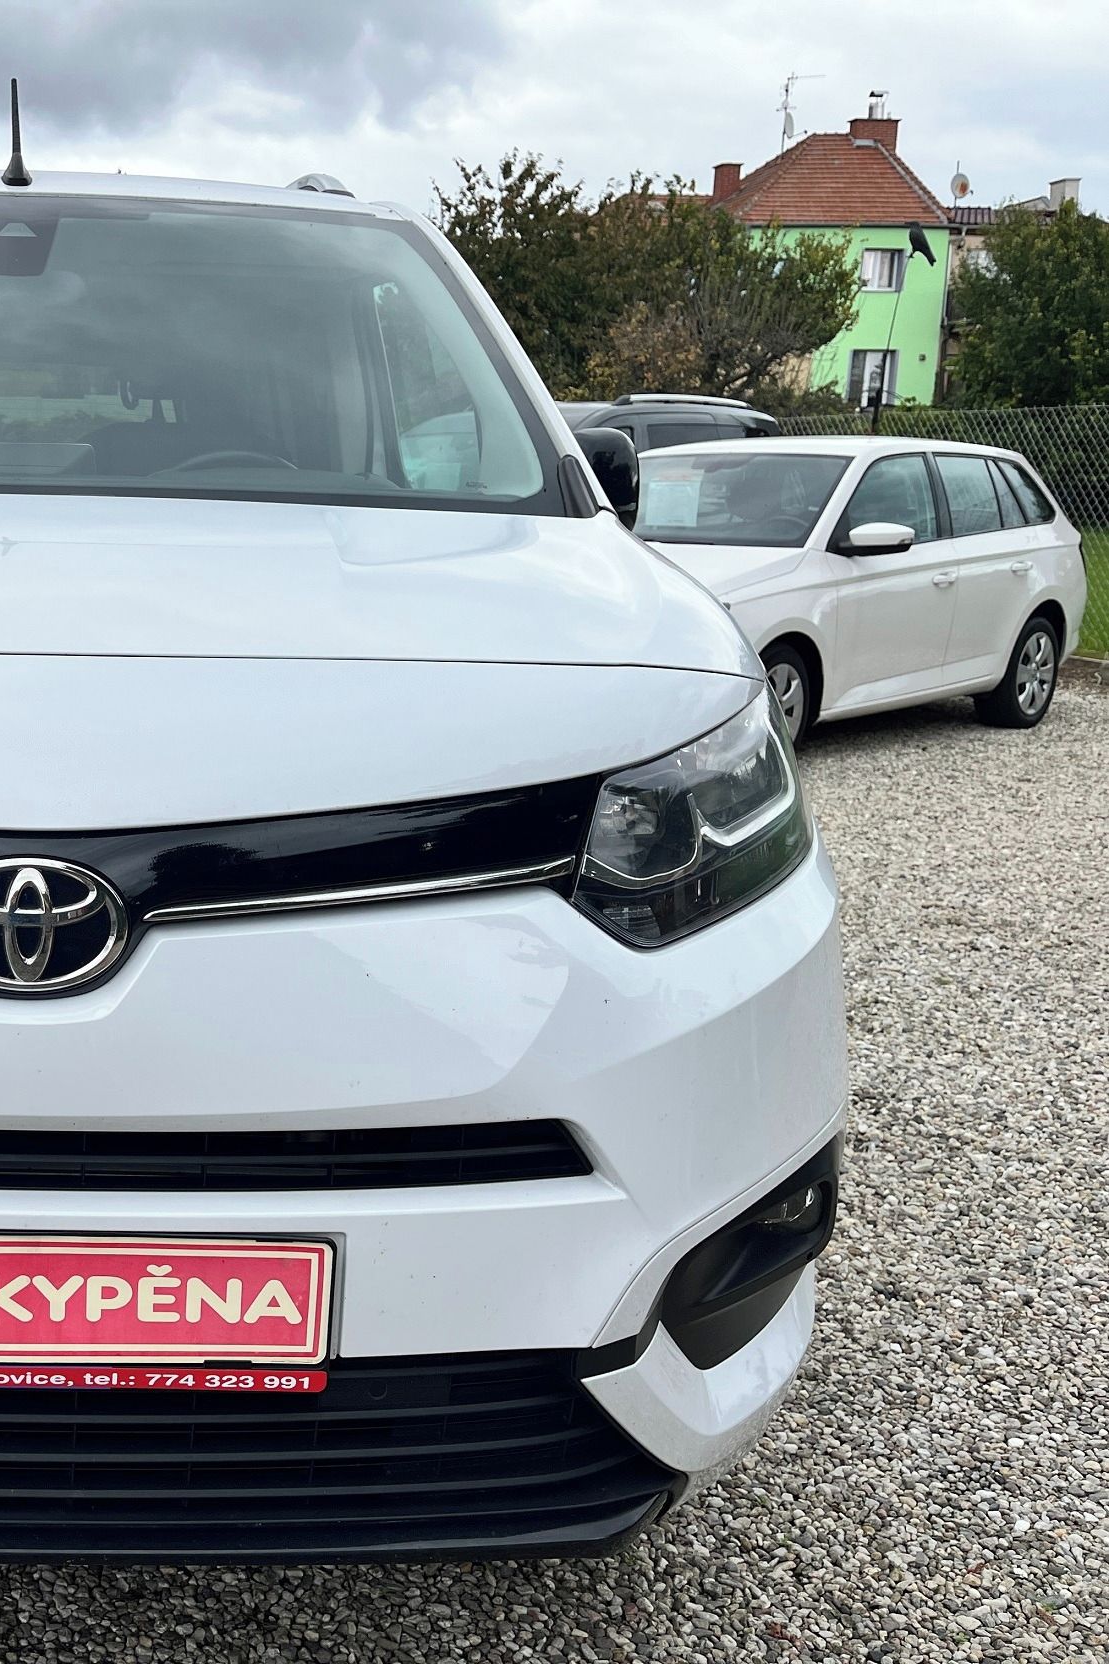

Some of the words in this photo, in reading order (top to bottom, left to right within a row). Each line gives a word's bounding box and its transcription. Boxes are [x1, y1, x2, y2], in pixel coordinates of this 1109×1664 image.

[83, 1371, 136, 1387] tel.:
[145, 1373, 196, 1387] 774
[204, 1374, 255, 1389] 323
[263, 1375, 310, 1390] 991
